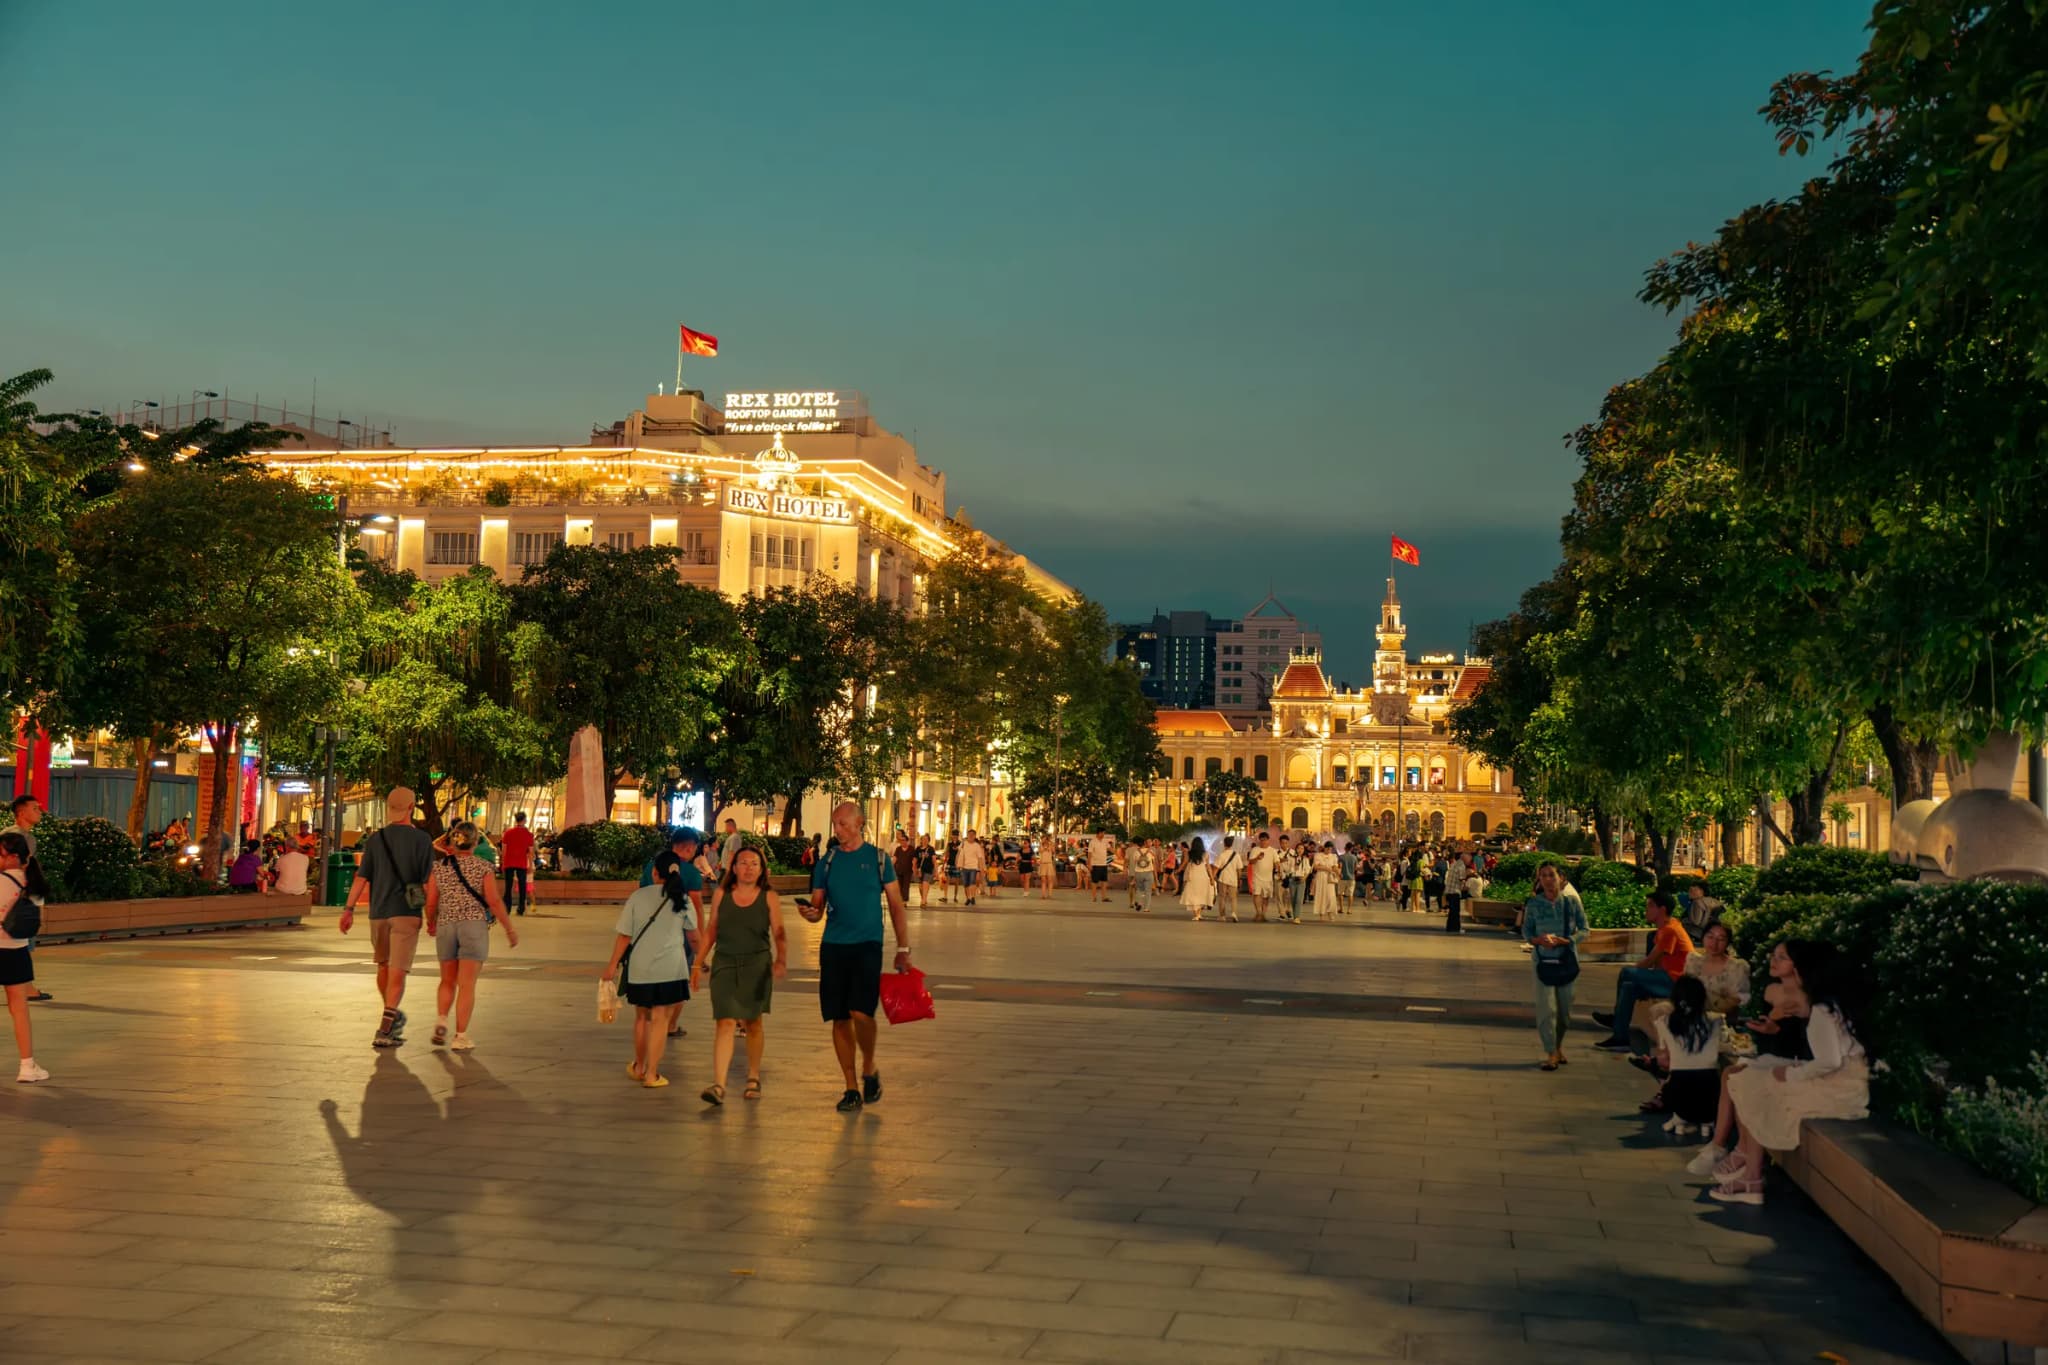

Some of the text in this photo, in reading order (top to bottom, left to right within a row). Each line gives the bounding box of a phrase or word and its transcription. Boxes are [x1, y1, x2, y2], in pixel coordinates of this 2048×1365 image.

[726, 392, 840, 407] REX HOTEL
[725, 408, 836, 419] ROOFTOP GARDEN BAR
[731, 490, 850, 519] REX HOTEL
